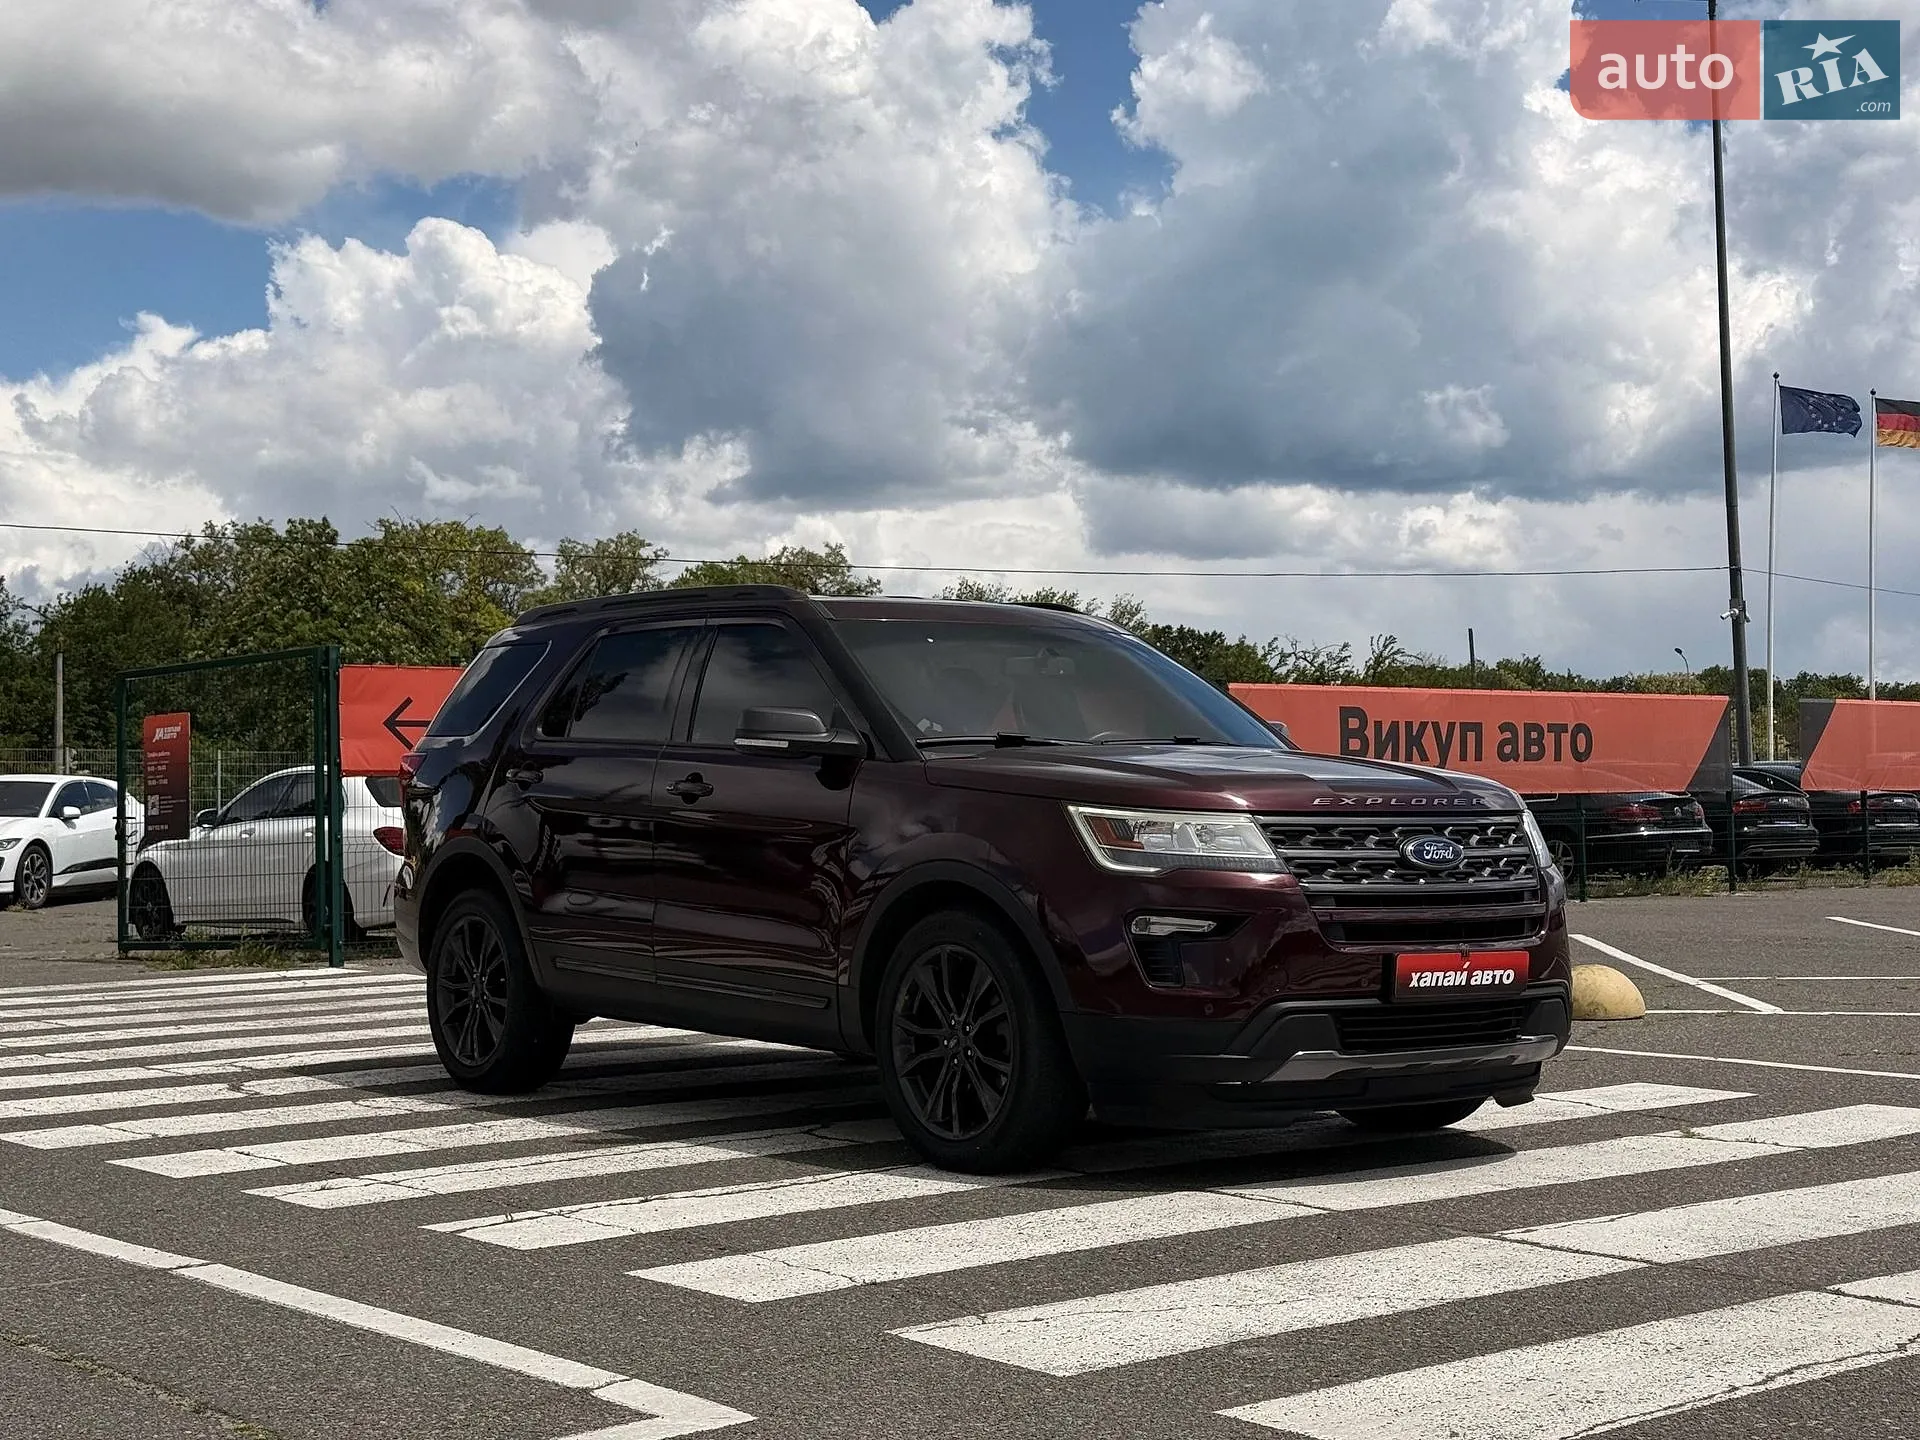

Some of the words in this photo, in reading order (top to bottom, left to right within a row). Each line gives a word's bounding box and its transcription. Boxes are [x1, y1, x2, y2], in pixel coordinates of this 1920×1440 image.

[1338, 706, 1484, 769] Викуп
[1497, 721, 1594, 762] авто
[1312, 796, 1486, 806] EXPLORER
[1423, 841, 1455, 860] Ford
[1470, 968, 1515, 987] авто
